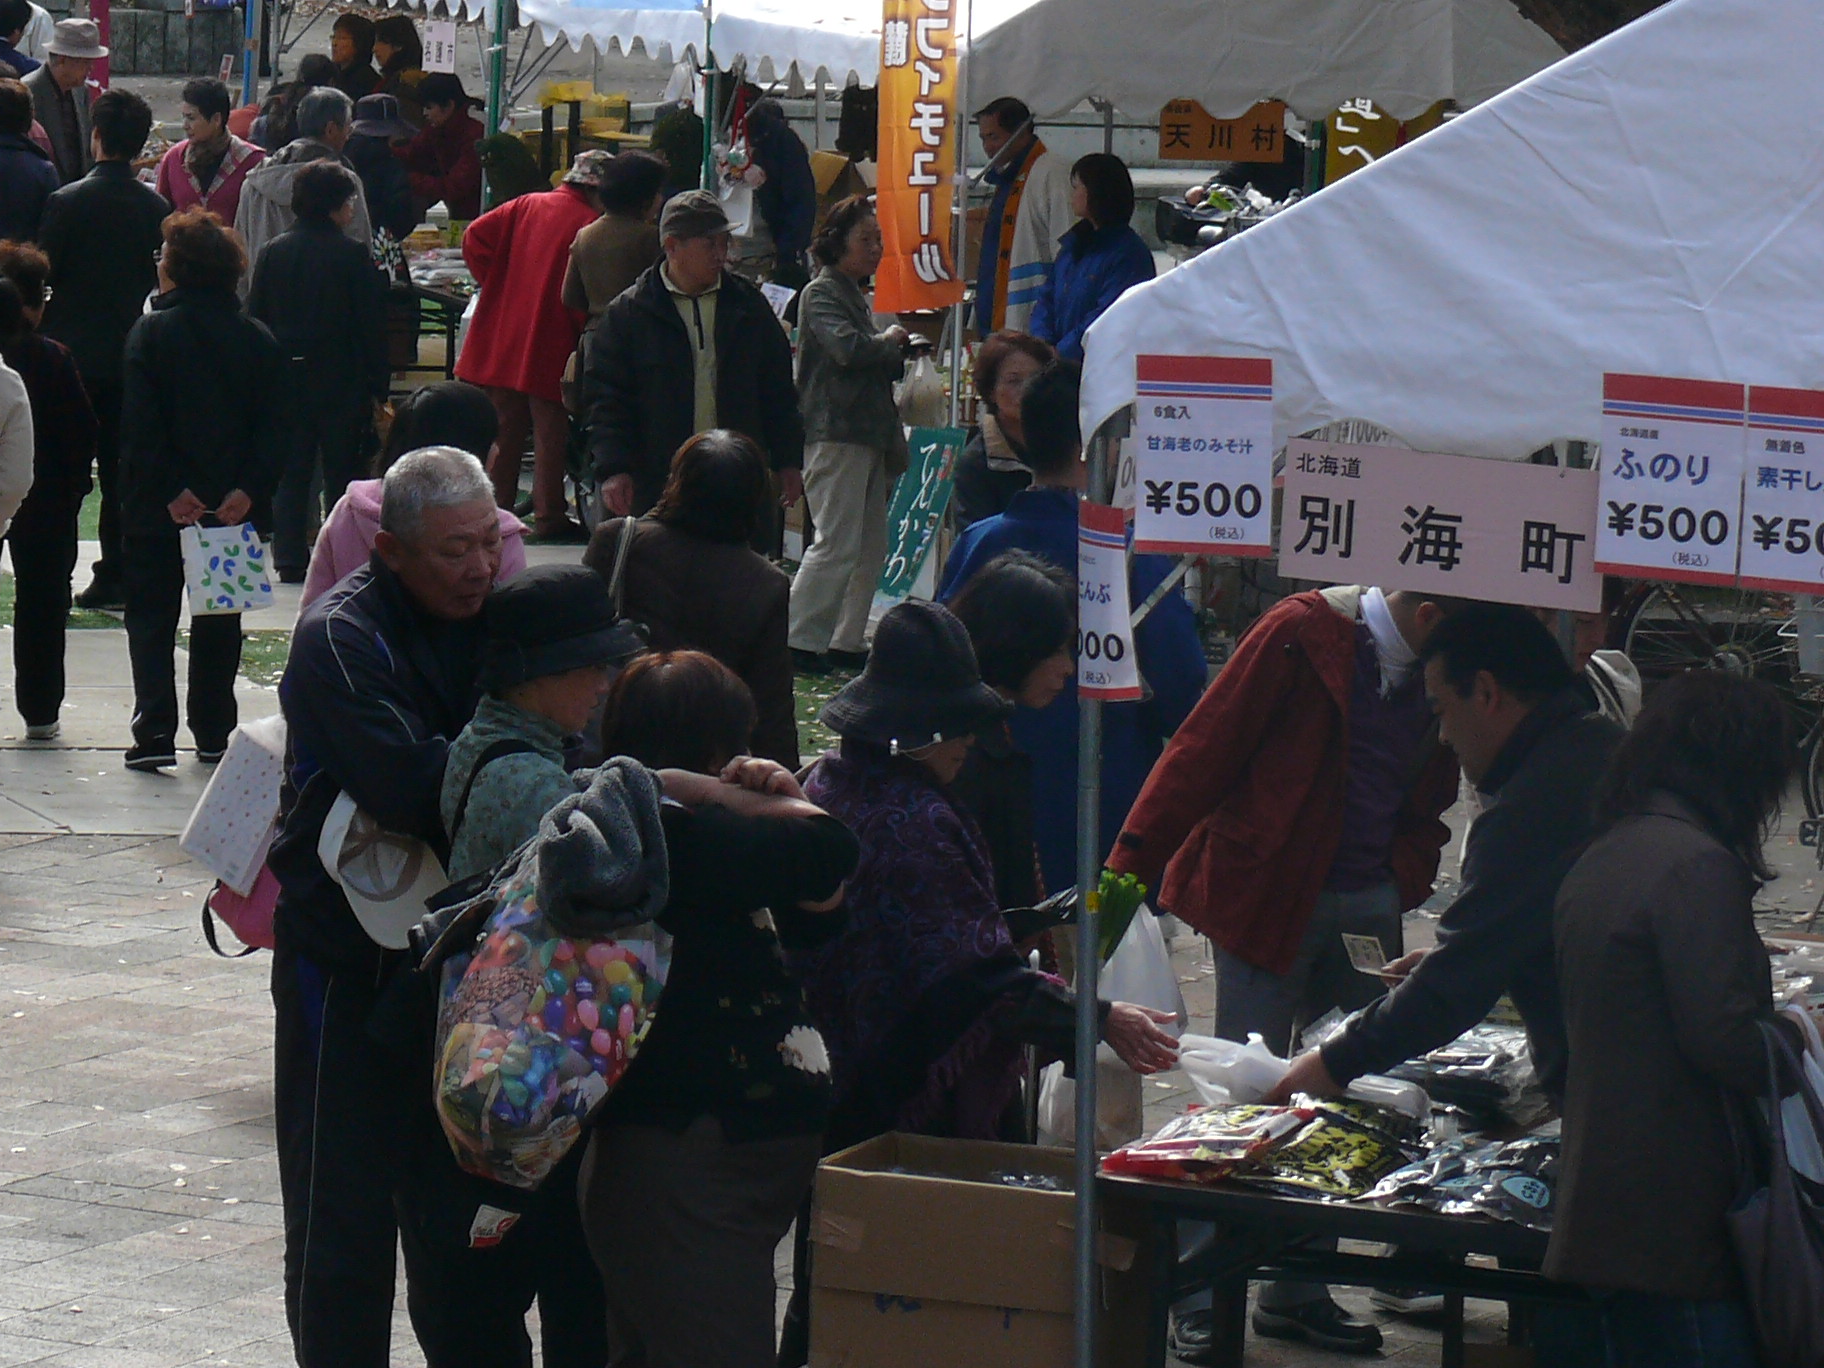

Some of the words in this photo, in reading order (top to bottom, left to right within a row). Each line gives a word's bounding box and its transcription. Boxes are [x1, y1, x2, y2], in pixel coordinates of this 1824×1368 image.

[1164, 123, 1276, 151] 天川村
[1146, 434, 1254, 455] 甘海老のみそ汁
[1295, 452, 1362, 479] 北海道
[1613, 448, 1710, 486] ふのり
[1756, 466, 1824, 492] 素干し
[1144, 480, 1263, 519] ¥500
[1293, 494, 1586, 584] 別海町
[1607, 500, 1729, 546] ¥500
